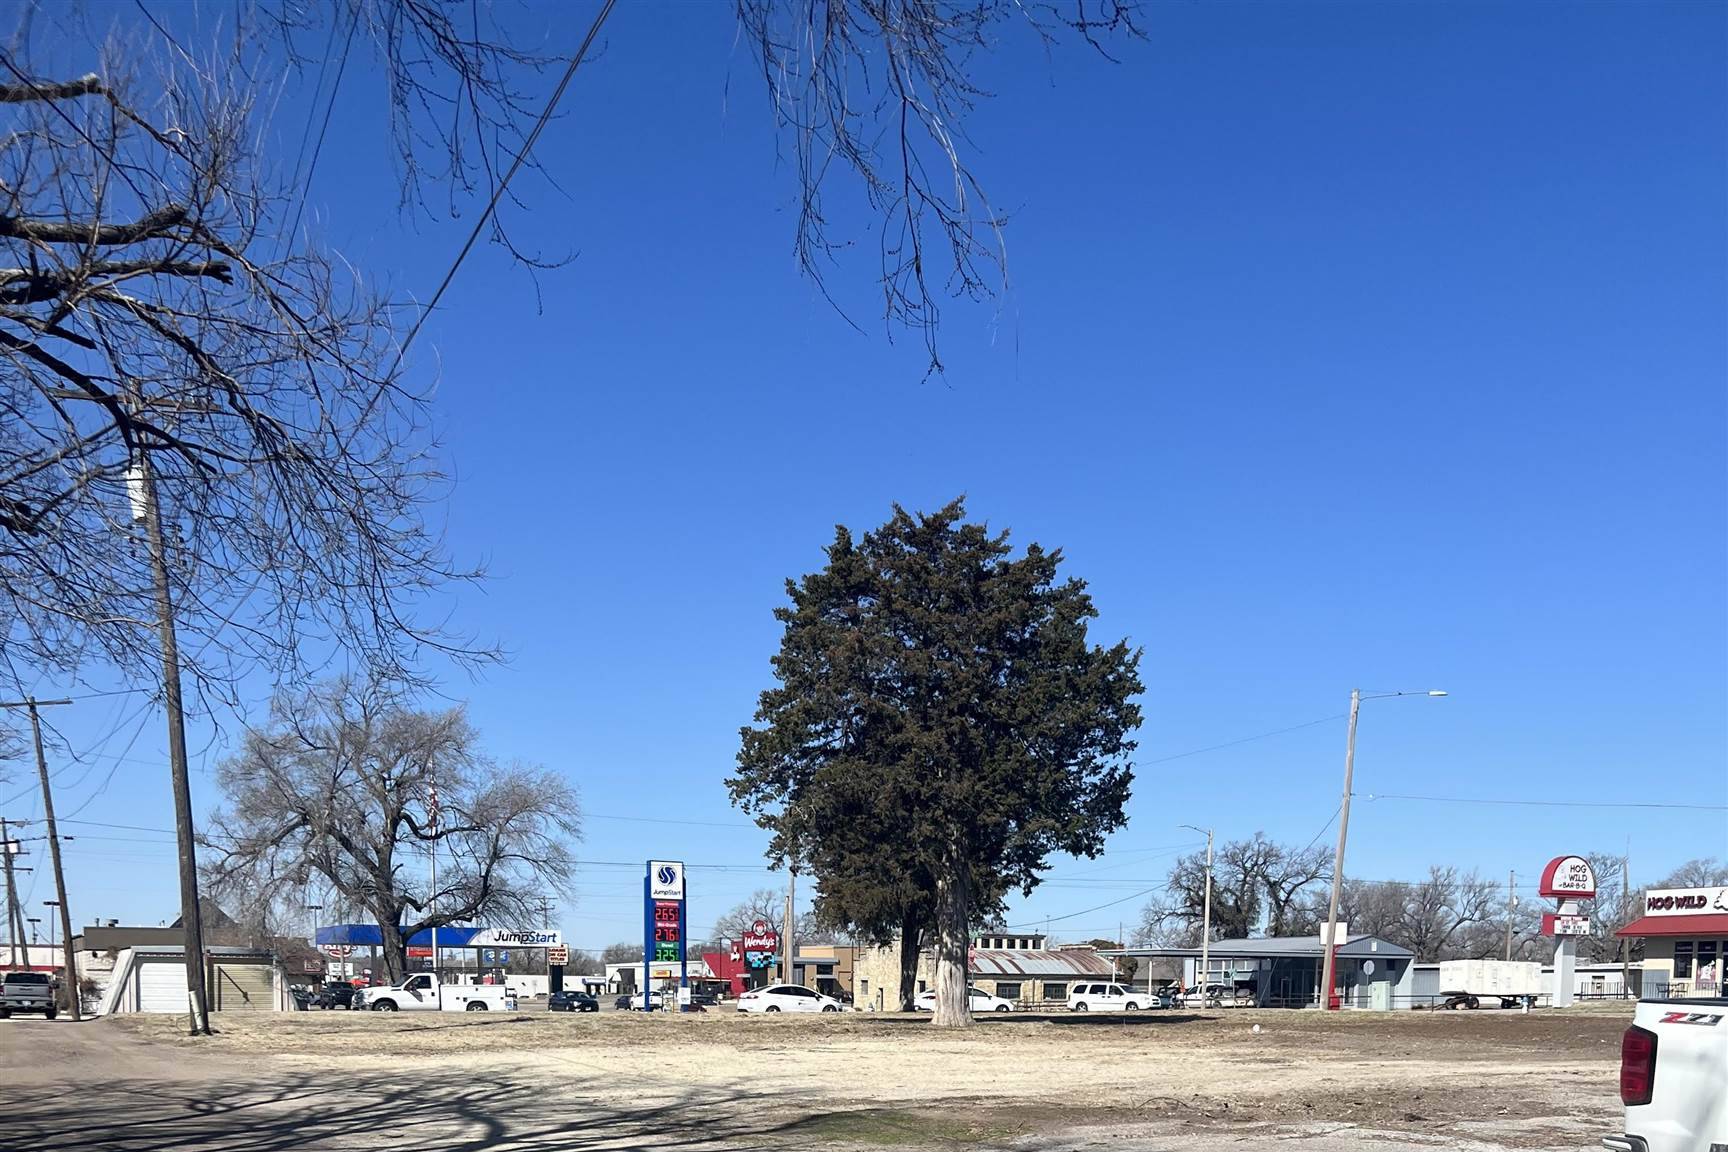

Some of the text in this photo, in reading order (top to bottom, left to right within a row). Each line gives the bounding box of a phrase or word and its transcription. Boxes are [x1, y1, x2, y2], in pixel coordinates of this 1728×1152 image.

[1569, 864, 1587, 873] HOG
[1568, 874, 1588, 882] WILD
[1647, 895, 1708, 911] HOG WILD
[494, 930, 558, 945] JumpStart
[744, 935, 775, 949] Wendy's
[1659, 1011, 1725, 1026] Z71
